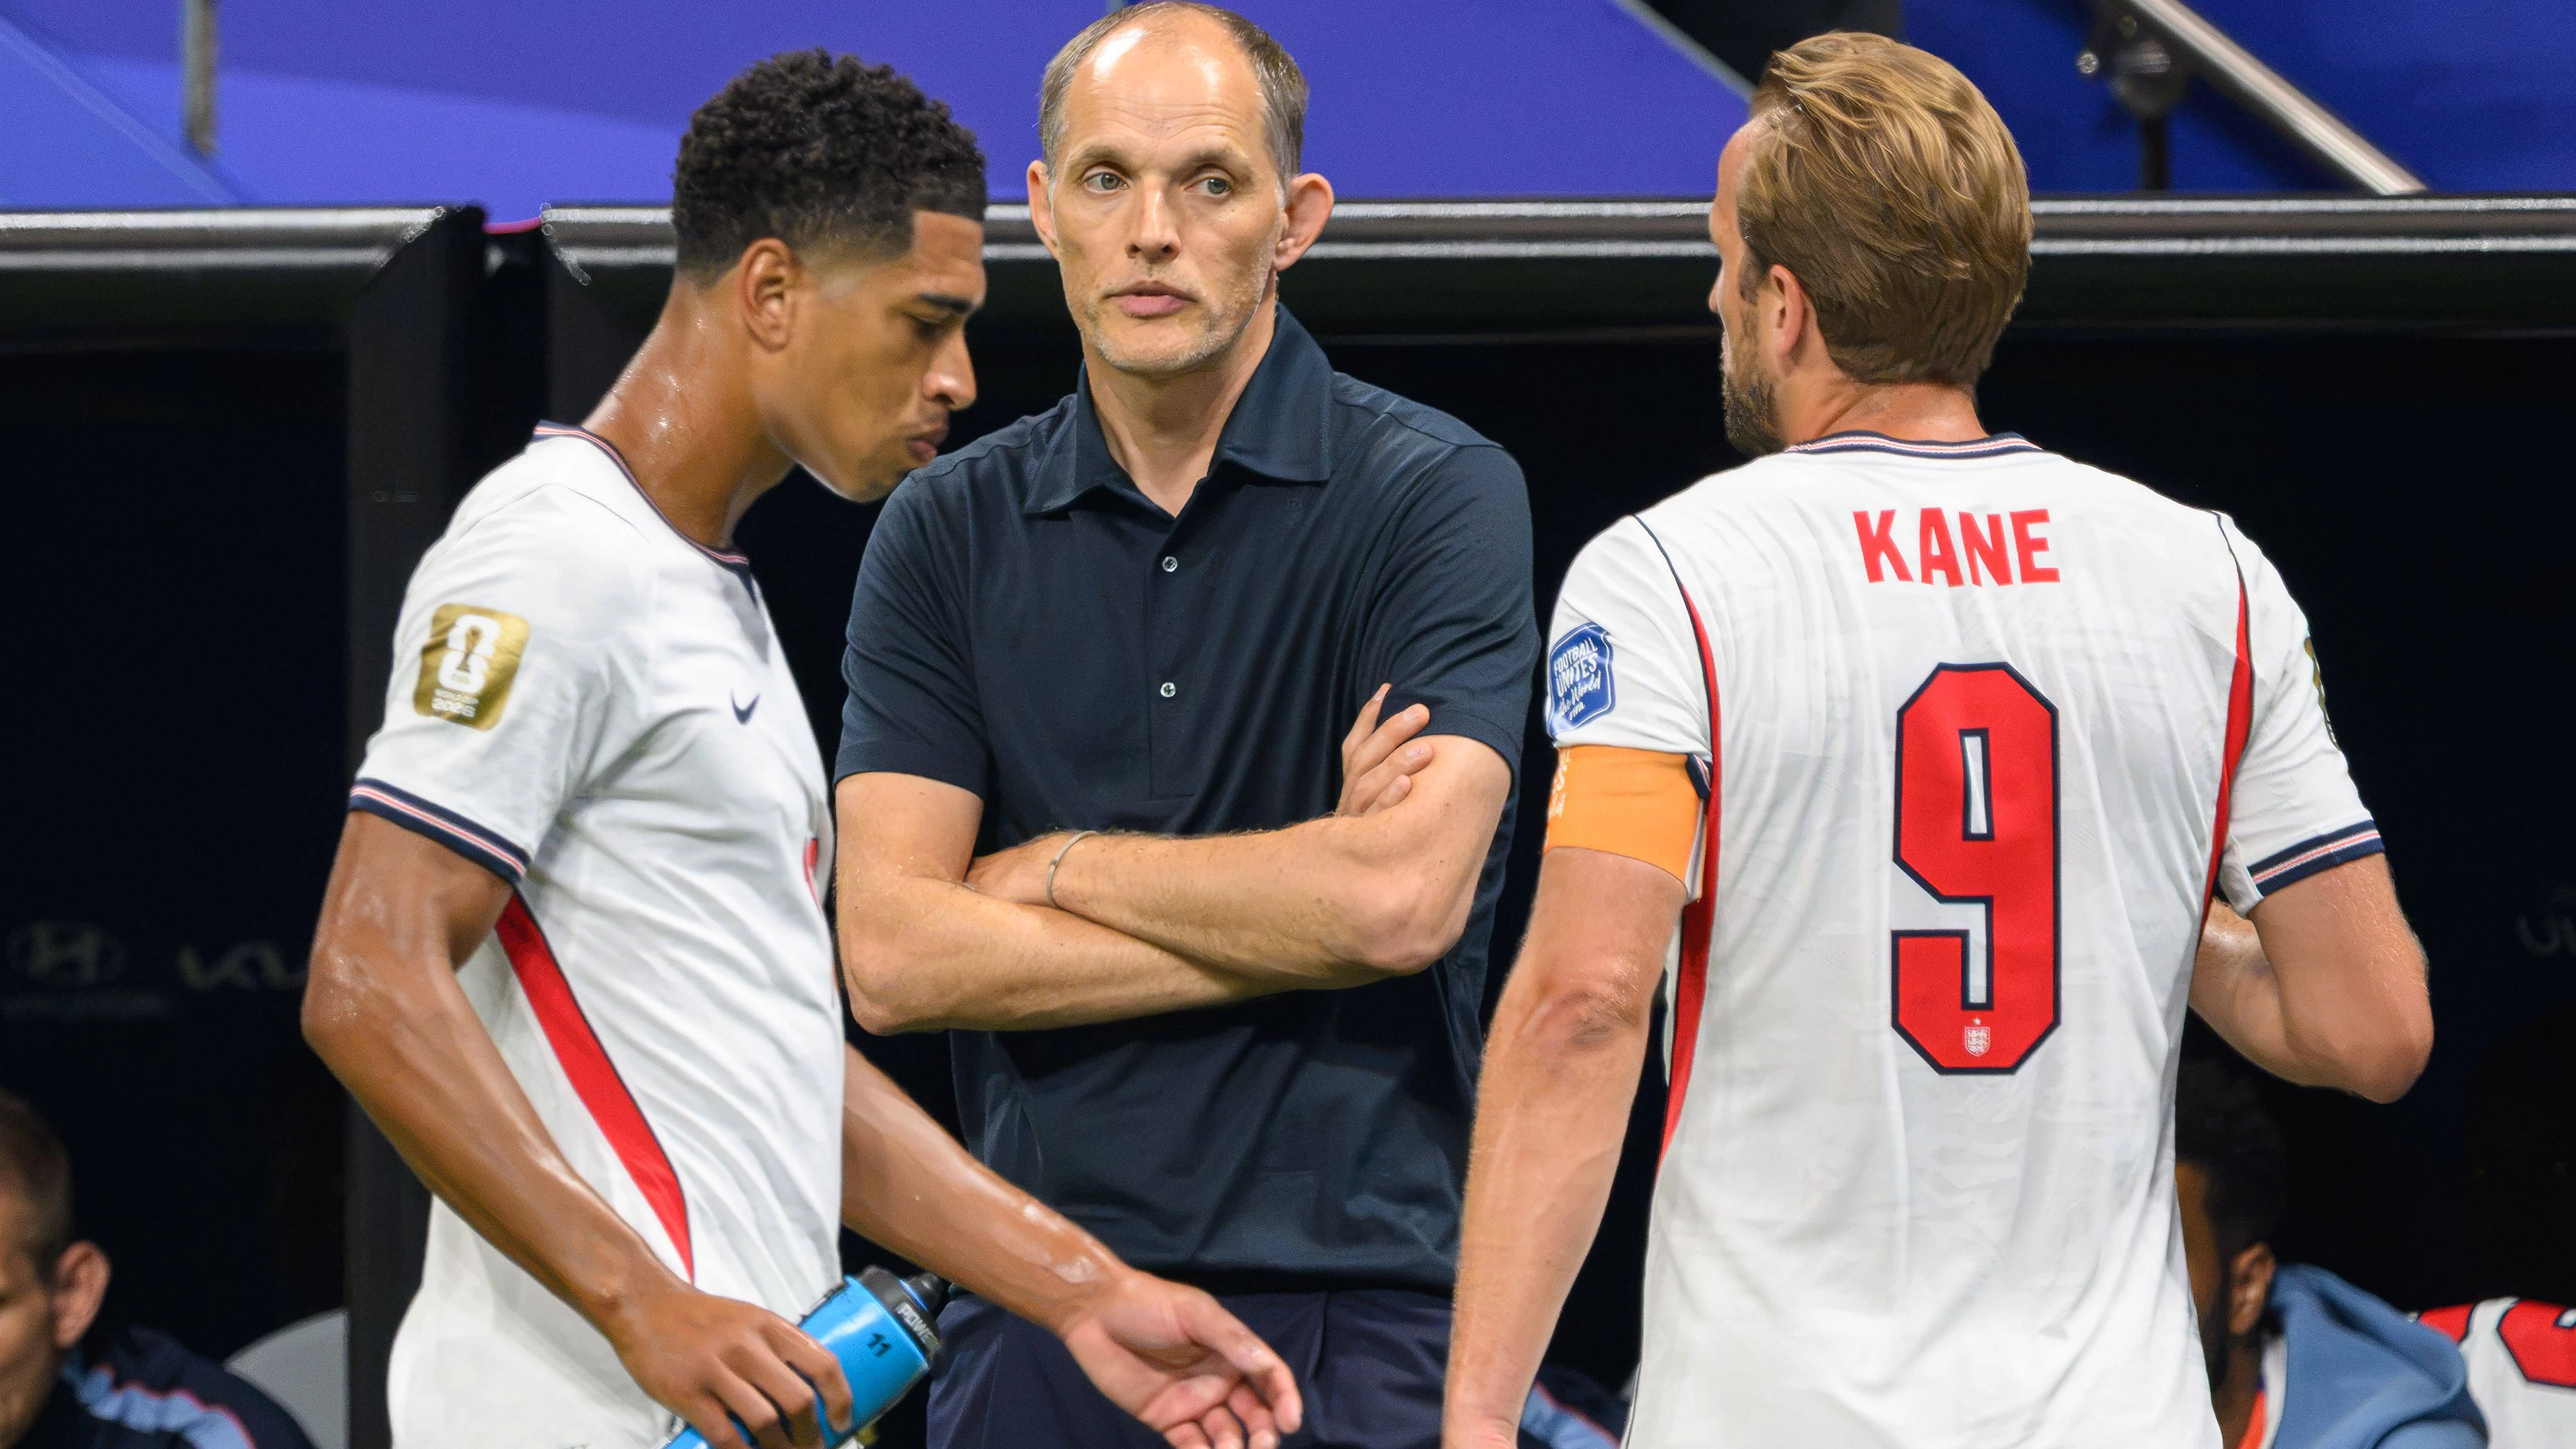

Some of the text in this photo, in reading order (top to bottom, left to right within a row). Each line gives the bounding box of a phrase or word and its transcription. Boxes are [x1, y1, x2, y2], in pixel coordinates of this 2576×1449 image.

[1853, 507, 2060, 587] KANE
[1554, 636, 1598, 677] FOOTBALL
[1556, 652, 1598, 697] UNITES
[1890, 661, 2061, 1076] 9
[867, 1332, 892, 1358] 11
